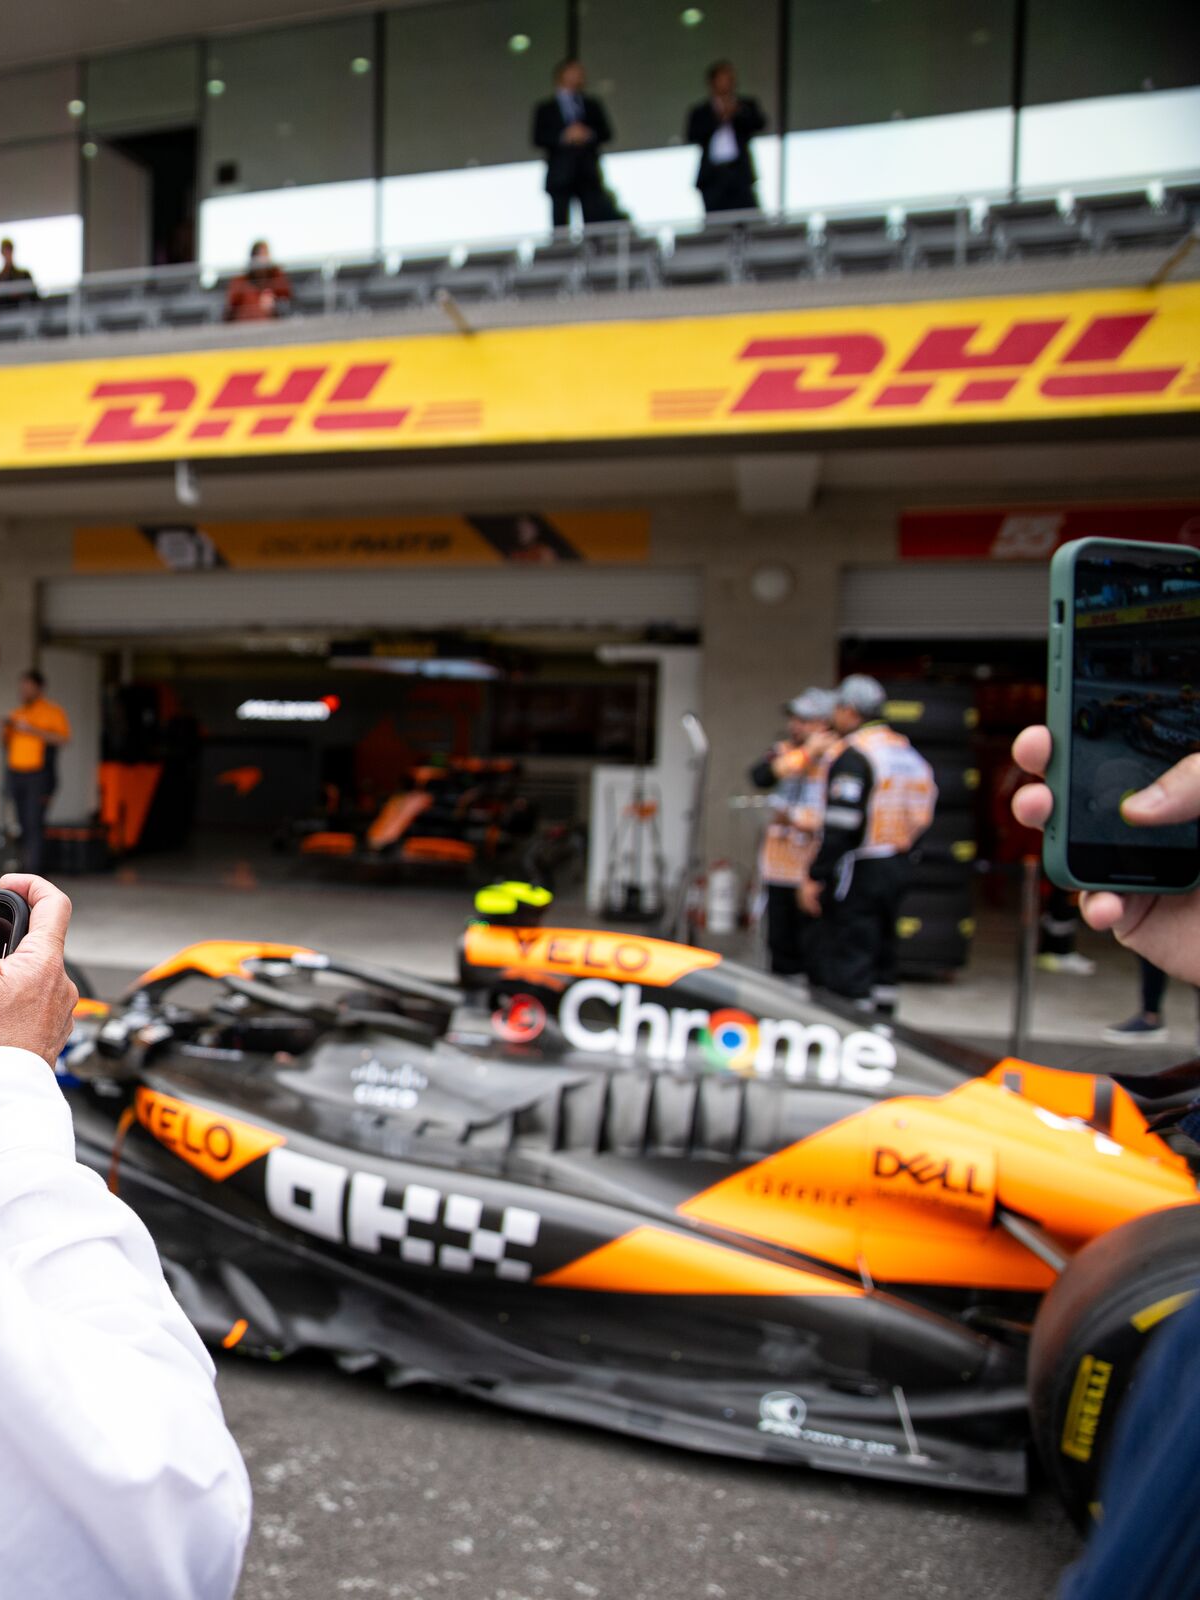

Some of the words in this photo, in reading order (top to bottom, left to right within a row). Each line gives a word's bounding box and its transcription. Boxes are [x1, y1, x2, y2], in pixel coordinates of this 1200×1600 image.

[85, 361, 412, 445] DHL
[729, 310, 1186, 413] DHL
[265, 1146, 540, 1283] OKX
